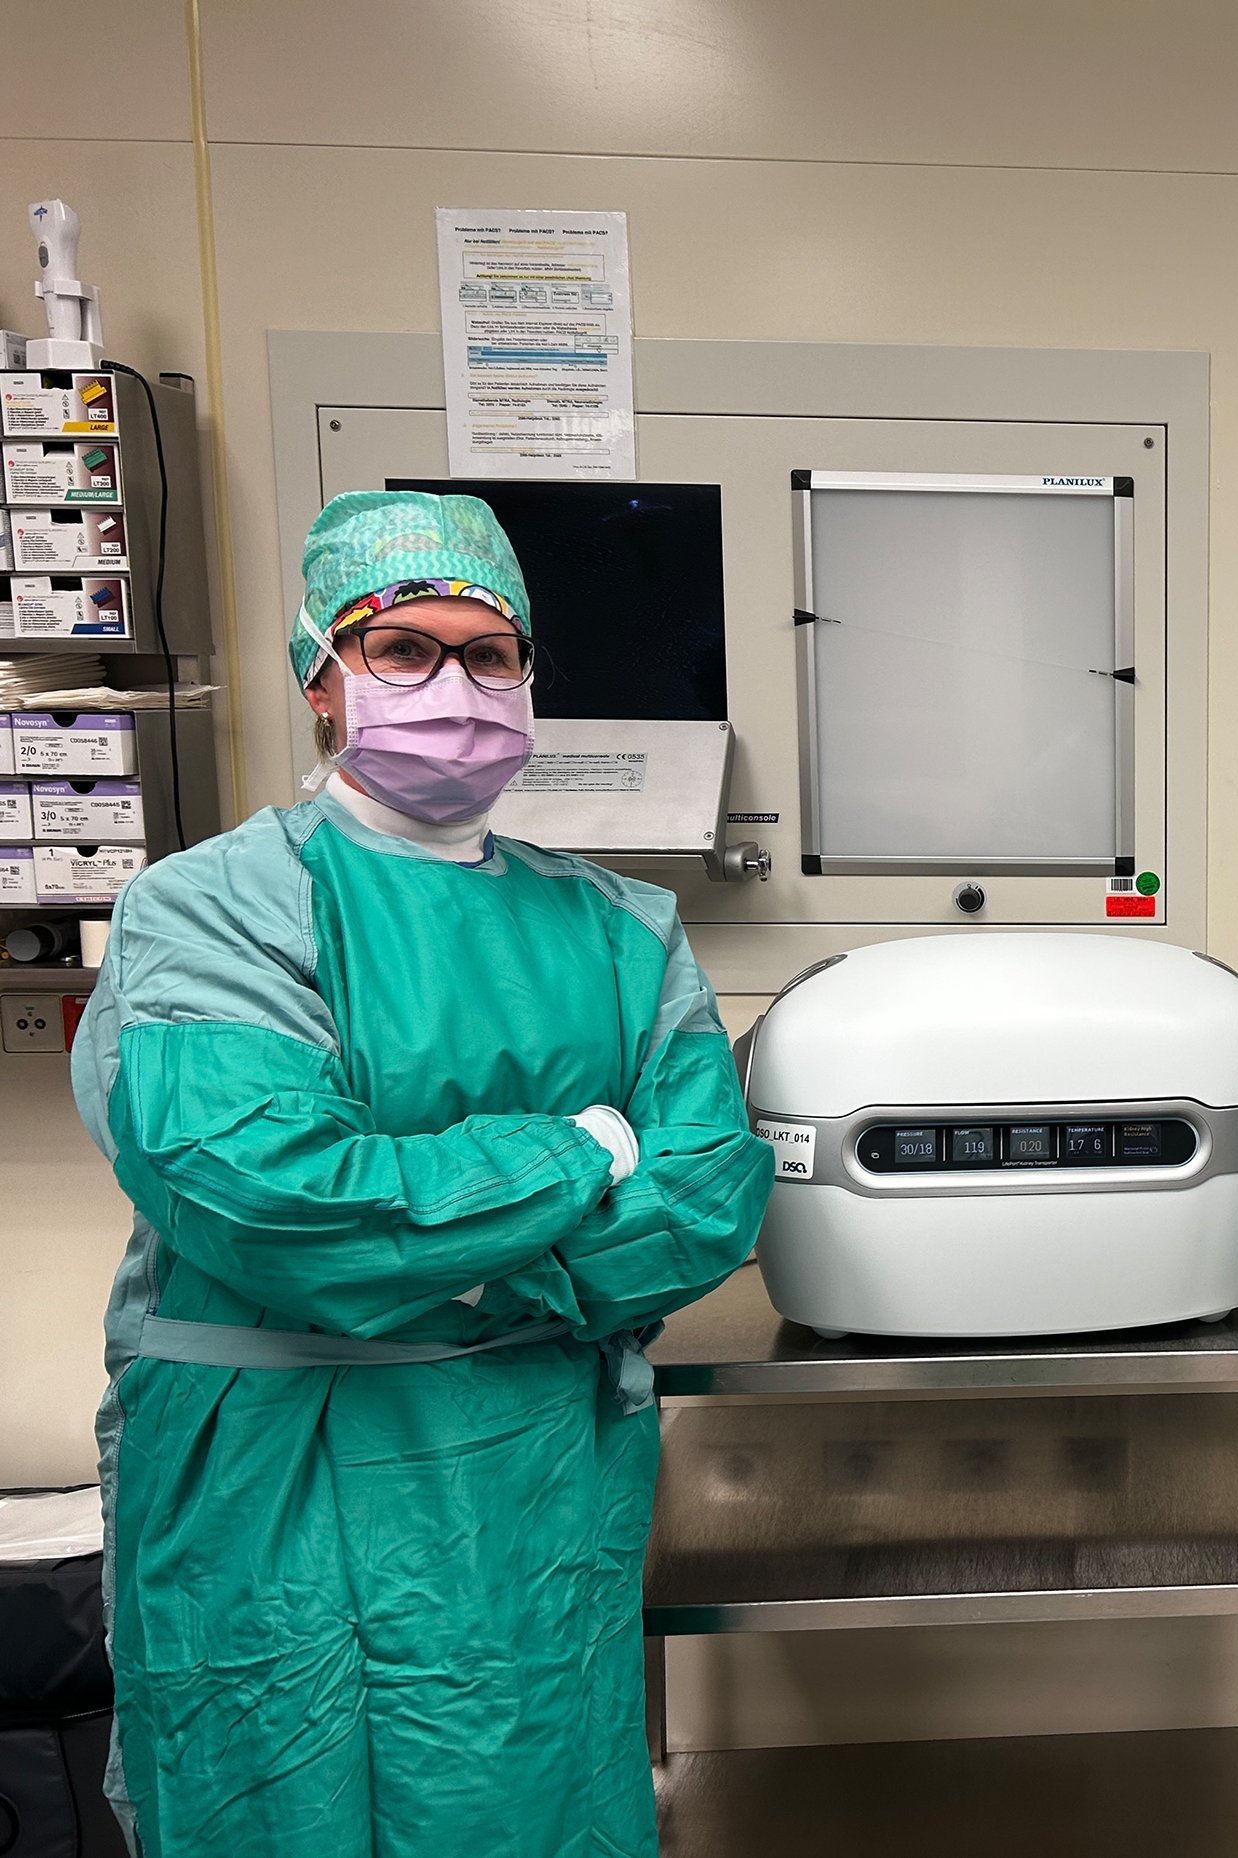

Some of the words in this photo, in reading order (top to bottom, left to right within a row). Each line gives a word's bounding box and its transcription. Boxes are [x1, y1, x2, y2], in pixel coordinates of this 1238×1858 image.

[1042, 477, 1103, 486] PLANILUX
[14, 718, 48, 728] Novosyn
[20, 746, 36, 755] 2/0
[34, 785, 65, 794] Novosyn
[41, 812, 56, 820] 3/0
[901, 1143, 933, 1155] 30/18
[964, 1142, 985, 1153] 119
[1094, 1139, 1101, 1150] 6
[783, 1161, 807, 1173] DSO
